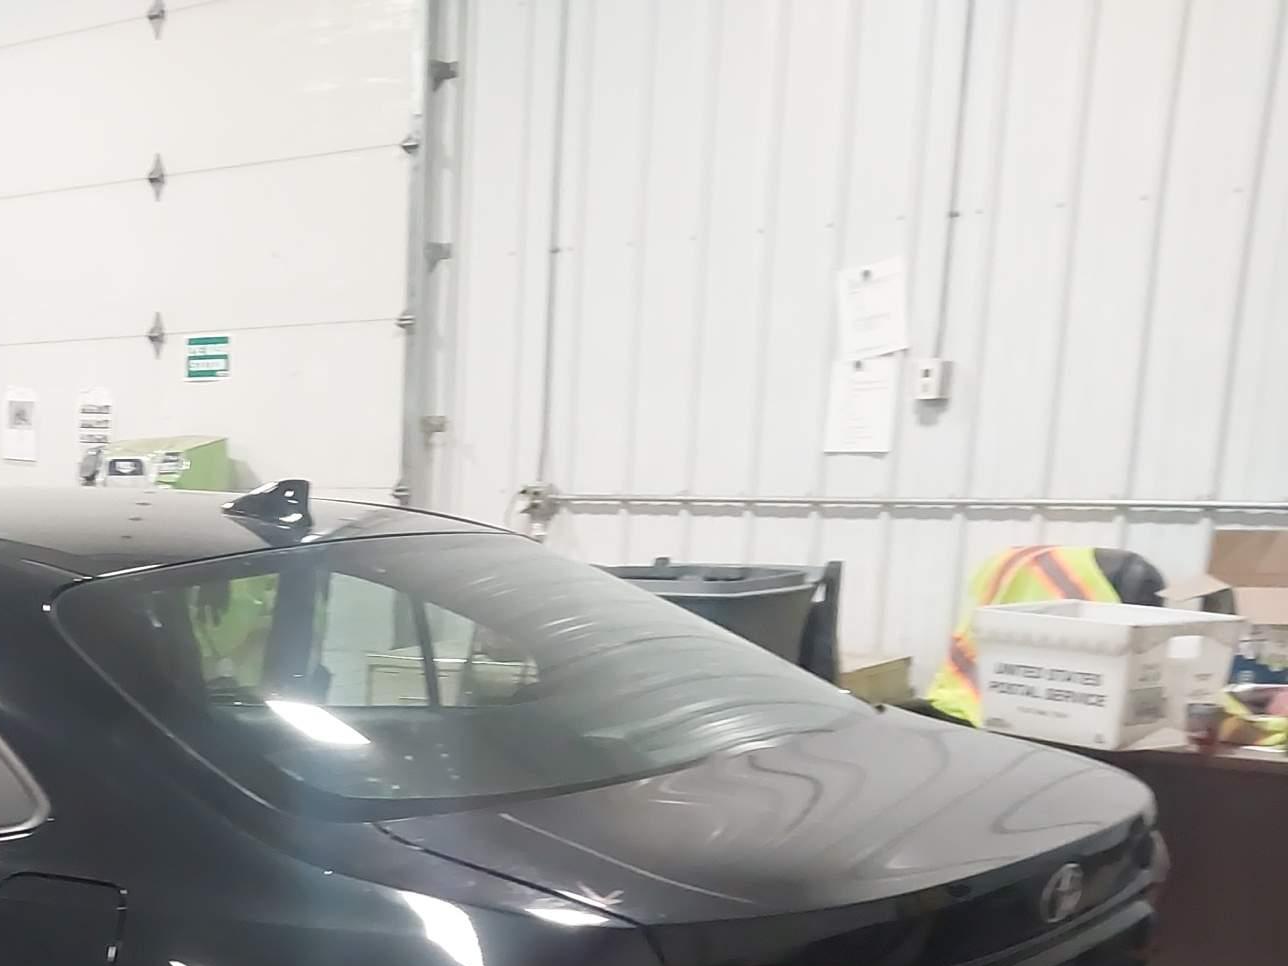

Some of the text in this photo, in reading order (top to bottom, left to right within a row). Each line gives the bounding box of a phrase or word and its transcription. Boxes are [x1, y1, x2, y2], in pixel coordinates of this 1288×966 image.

[993, 662, 1103, 687] UNITED STATES
[988, 680, 1108, 708] POSTAL SERVICE
